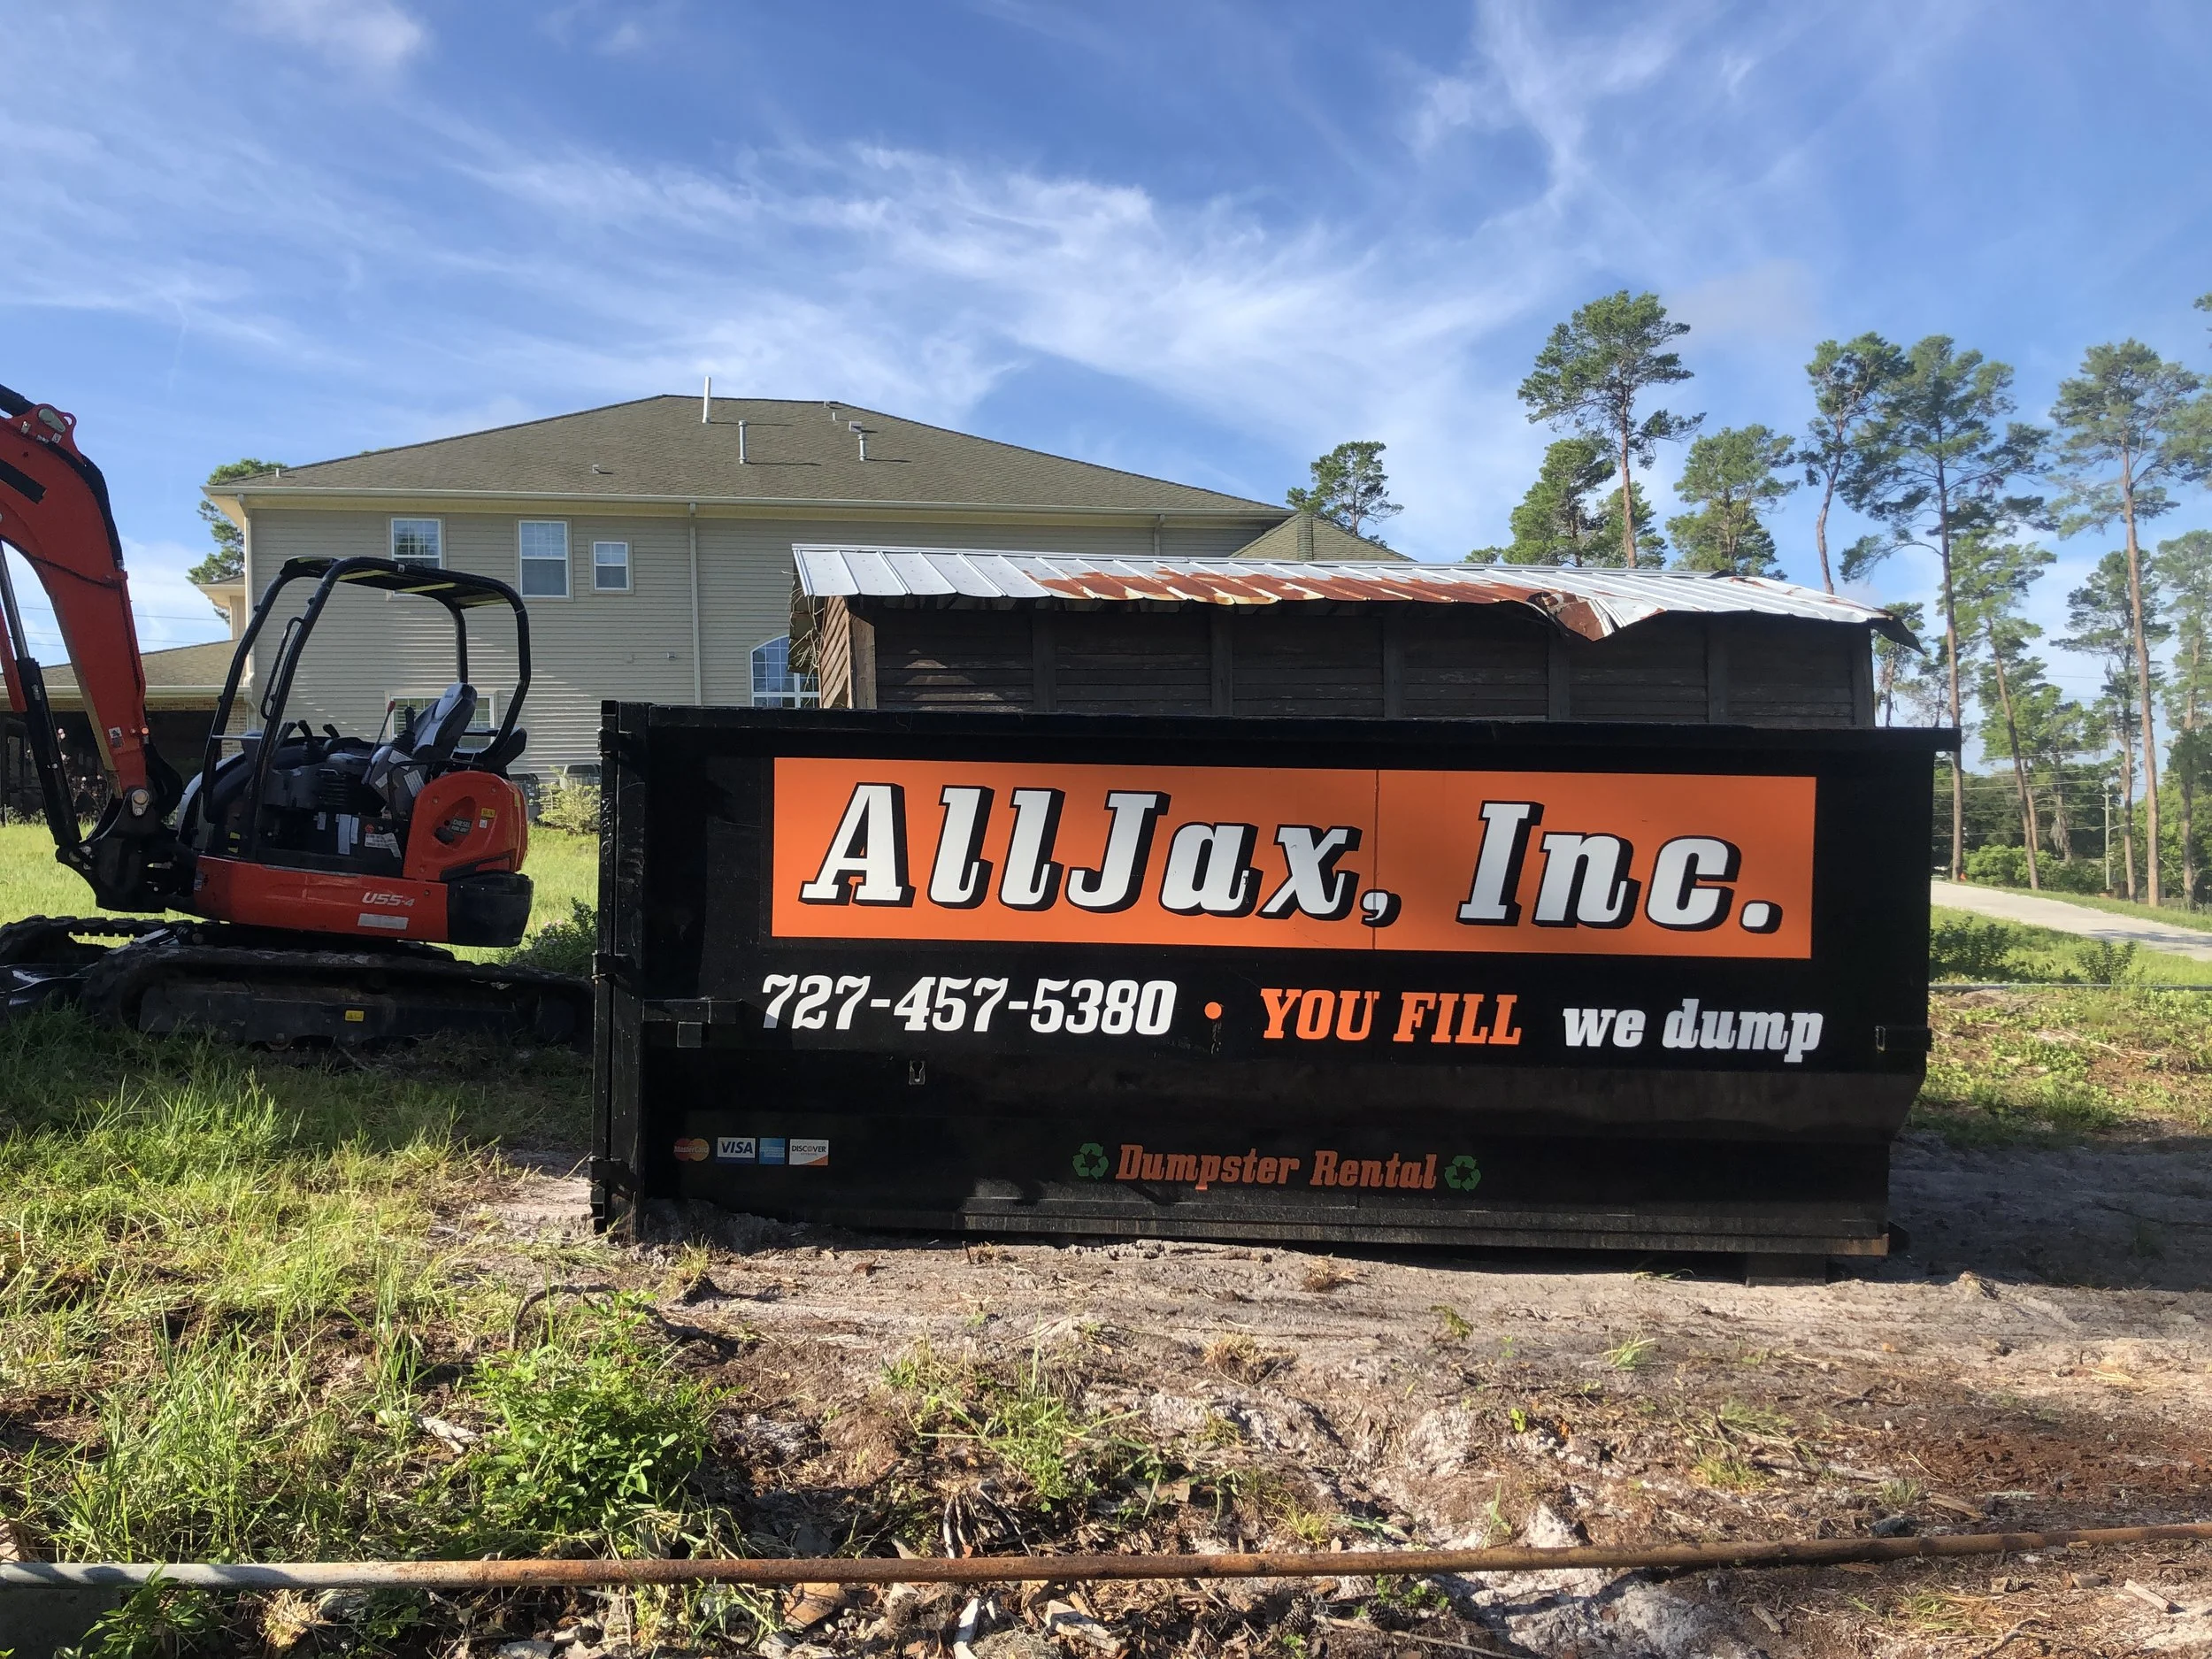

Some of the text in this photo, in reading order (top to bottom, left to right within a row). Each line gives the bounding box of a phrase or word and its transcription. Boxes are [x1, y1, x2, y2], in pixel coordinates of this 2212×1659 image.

[799, 782, 1784, 933] AllJax, Inc.
[362, 892, 415, 907] U55-4
[762, 973, 1824, 1063] 727-457-5380 YOU FILL we dump
[721, 1141, 753, 1154] VISA
[791, 1144, 826, 1153] DISCOVER
[1116, 1144, 1437, 1191] Dumpster Rental
